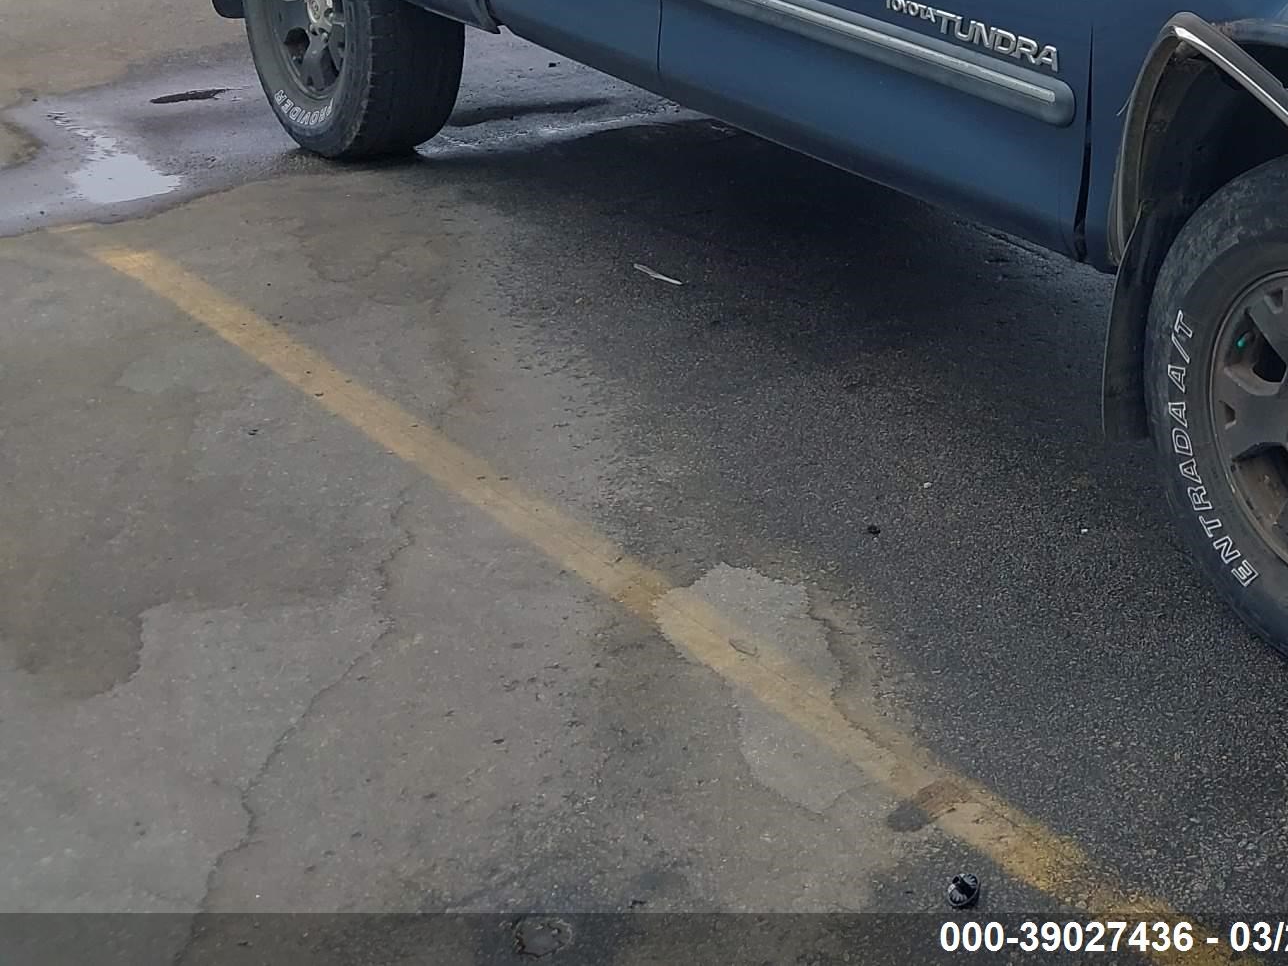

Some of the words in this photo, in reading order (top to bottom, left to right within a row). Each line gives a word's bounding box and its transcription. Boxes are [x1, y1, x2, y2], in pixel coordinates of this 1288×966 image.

[935, 9, 1059, 73] TUNDRA
[274, 89, 334, 125] PROVIDER
[1167, 309, 1194, 393] A/T
[1167, 401, 1260, 587] ENTRADA
